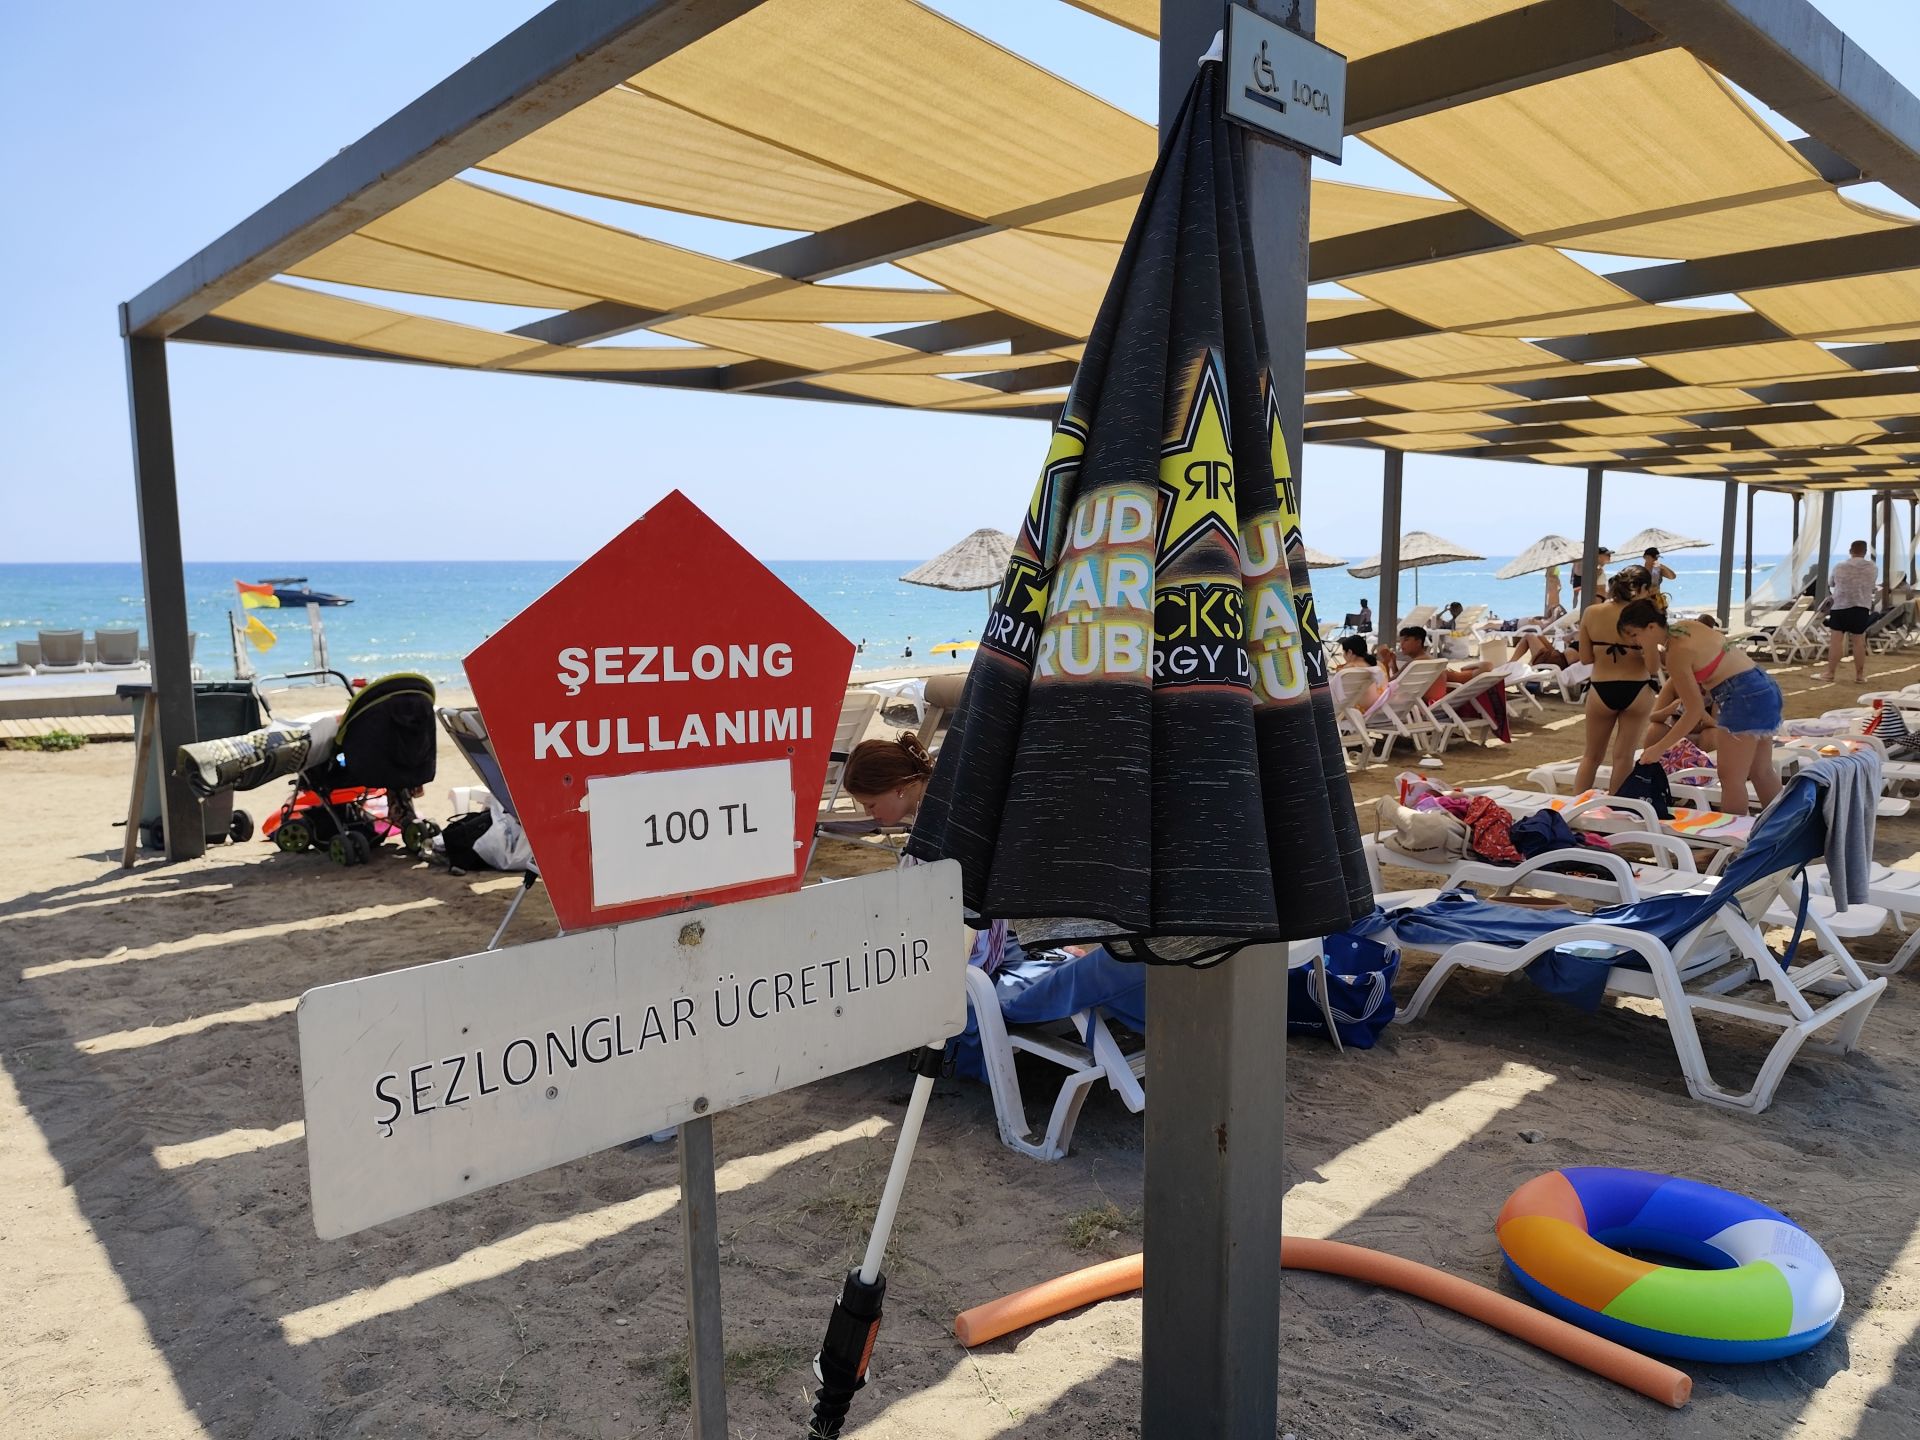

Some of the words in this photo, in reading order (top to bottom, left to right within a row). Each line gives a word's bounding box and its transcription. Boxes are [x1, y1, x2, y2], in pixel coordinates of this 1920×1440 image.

[1291, 79, 1332, 116] LOCA
[1060, 495, 1153, 560] UD
[1050, 558, 1151, 616] AR
[557, 643, 794, 697] ŞEZLONG
[1033, 611, 1154, 680] RÜB
[533, 706, 813, 760] KULLANIMI
[644, 807, 710, 847] 100
[719, 803, 758, 836] TL
[374, 998, 698, 1138] ŞEZLONGLAR
[714, 932, 931, 1028] ÜCRETLİDİR
